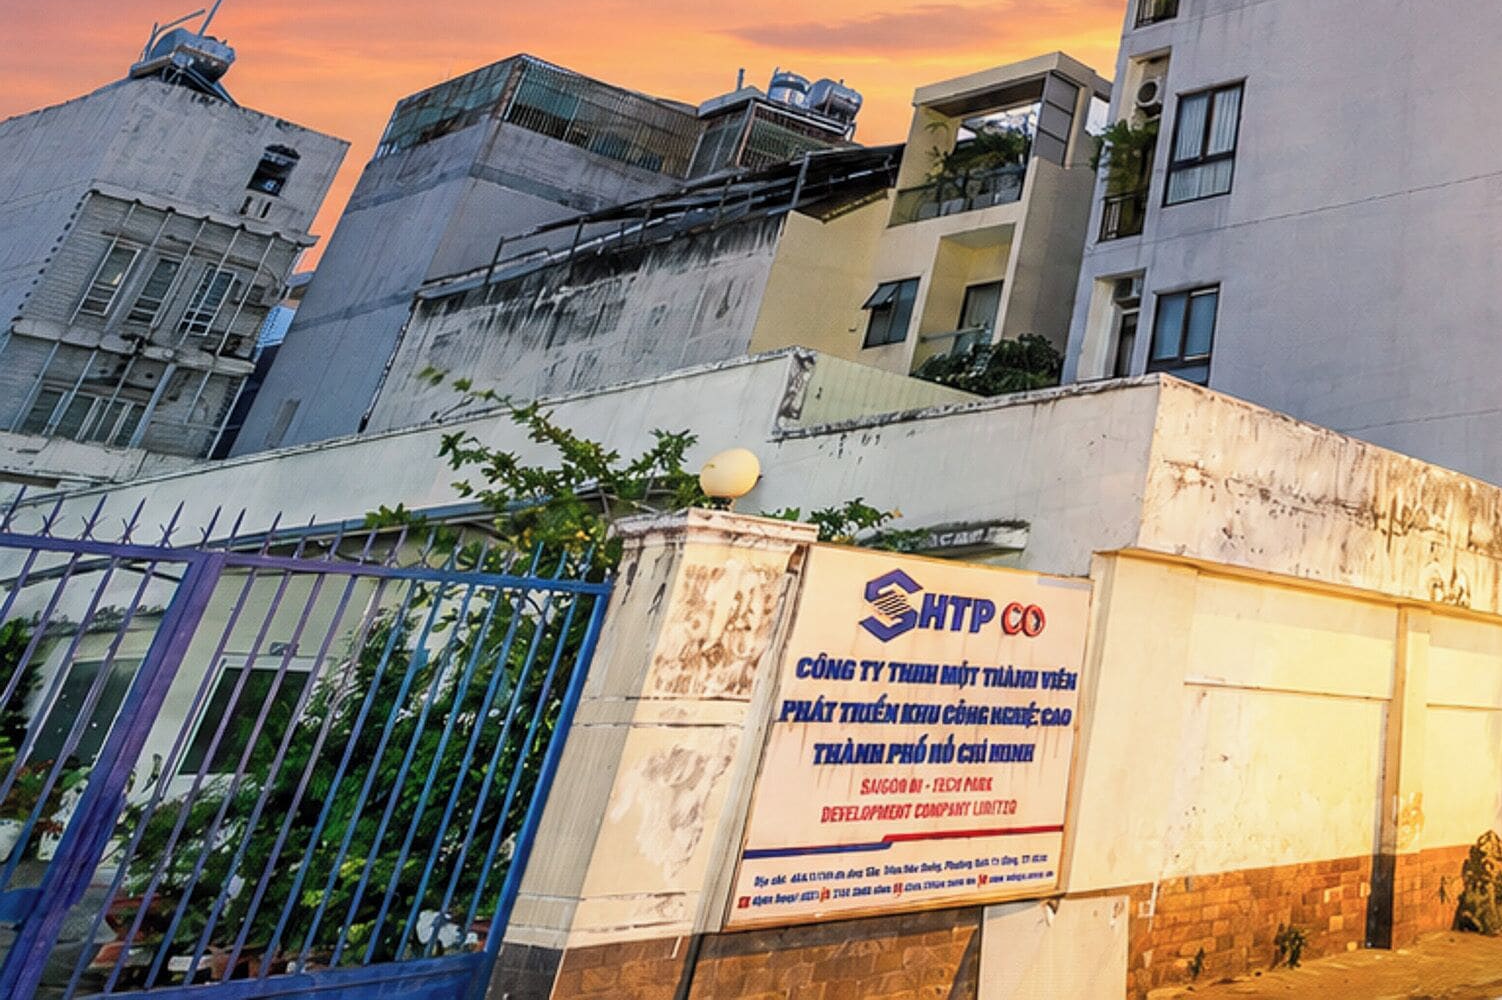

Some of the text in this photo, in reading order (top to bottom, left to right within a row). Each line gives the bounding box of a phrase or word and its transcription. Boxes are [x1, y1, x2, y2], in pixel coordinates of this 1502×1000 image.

[1001, 602, 1046, 637] CO
[795, 652, 857, 680] CÔNG
[860, 660, 885, 682] TY
[779, 694, 838, 722] PHÁT
[901, 703, 942, 724] KHU
[1041, 708, 1073, 726] CAO
[813, 737, 886, 765] THÀNH
[821, 803, 914, 823] DEVELOPMENT
[914, 802, 972, 819] COMPANY
